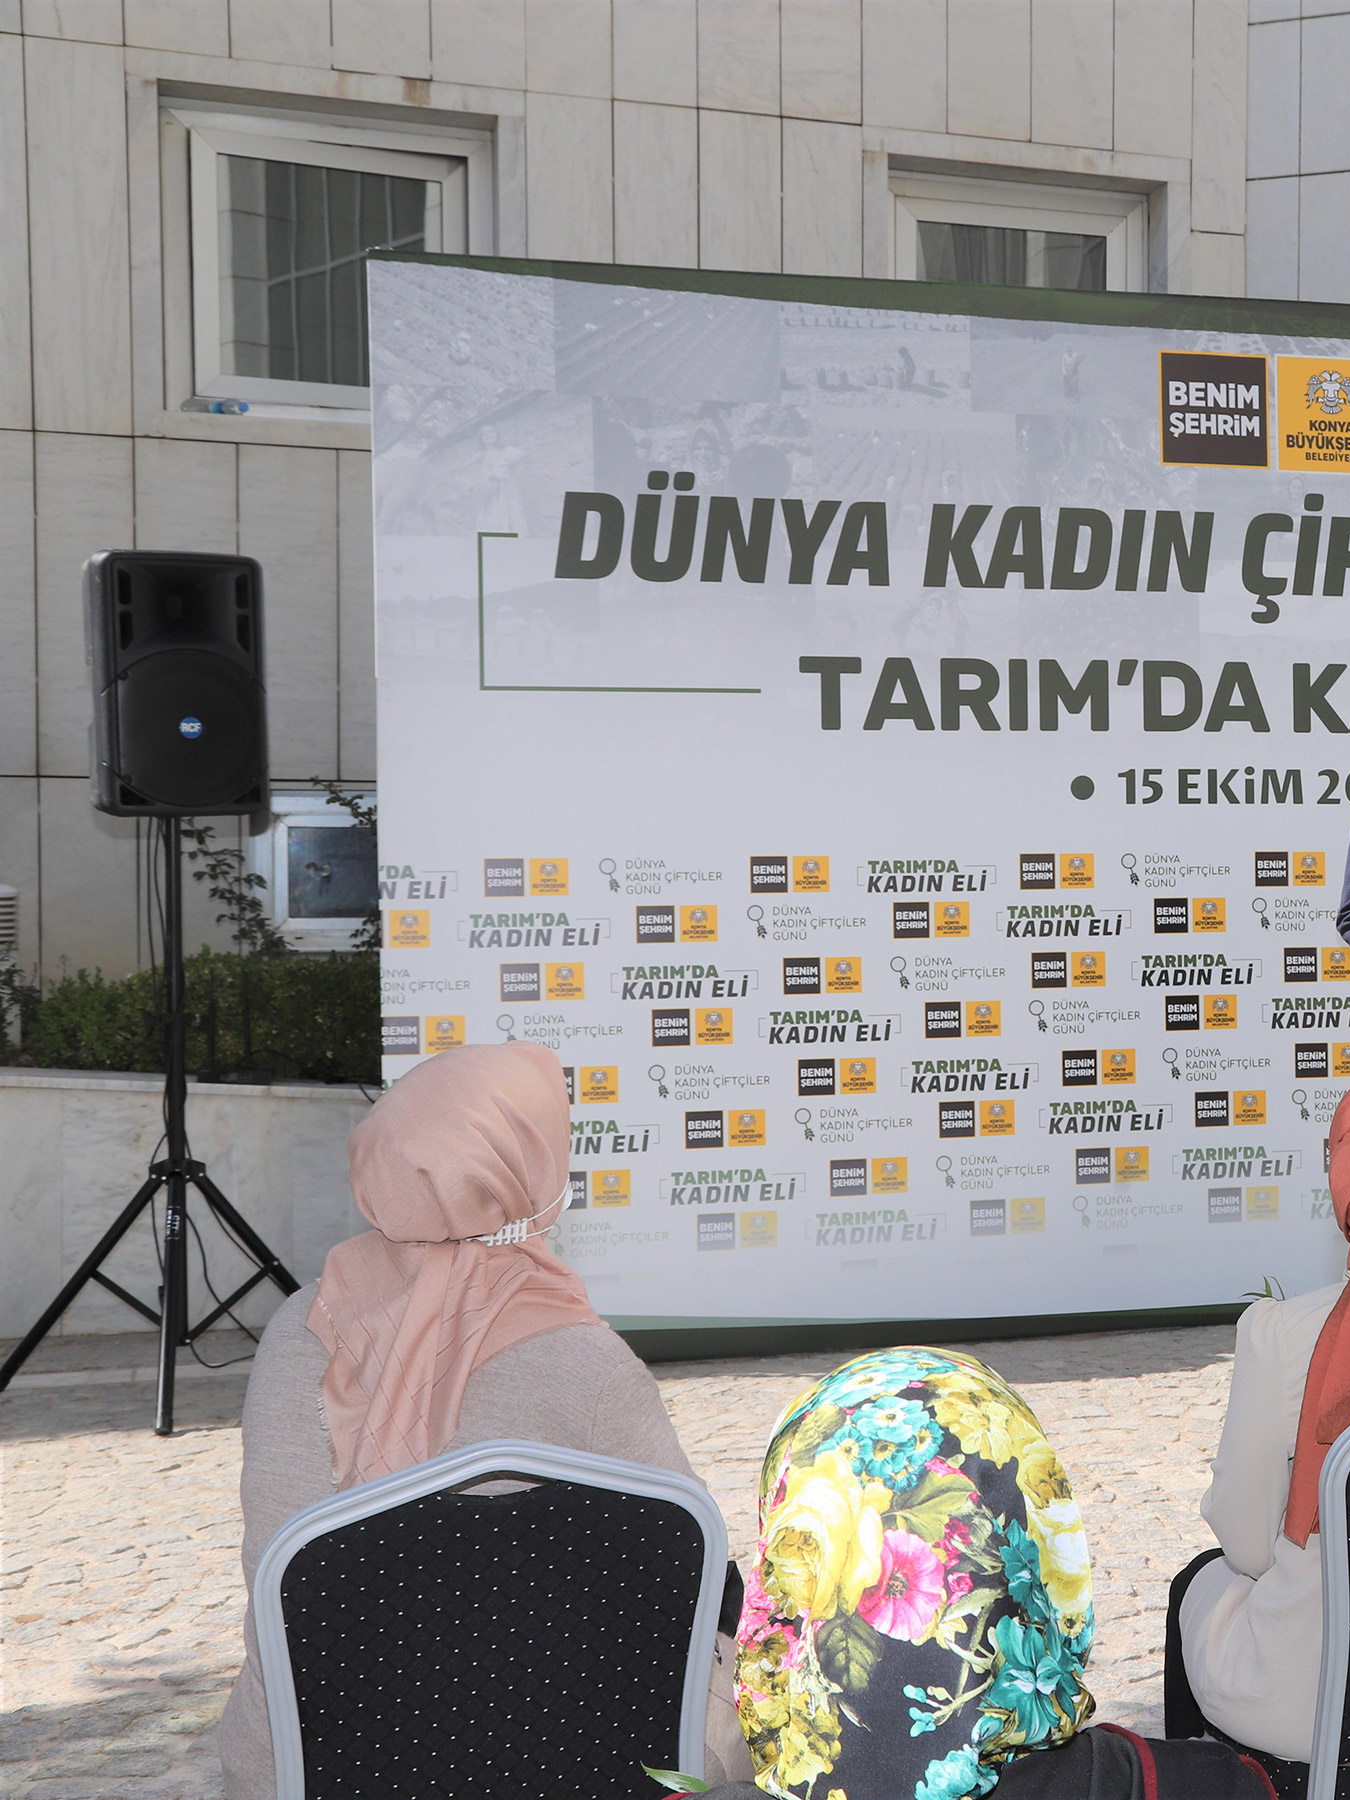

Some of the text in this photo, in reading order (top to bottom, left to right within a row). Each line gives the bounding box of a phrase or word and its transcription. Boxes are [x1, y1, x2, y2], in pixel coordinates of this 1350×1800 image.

[555, 471, 890, 587] DÜNYA
[924, 504, 1214, 593] KADIN
[799, 656, 1271, 732] TARIM'DA
[181, 722, 201, 732] RCF
[1118, 768, 1164, 804] 15
[625, 857, 666, 870] DÜNYA
[1144, 853, 1181, 864] DÜNYA
[868, 859, 959, 874] TARIM'DA
[1144, 864, 1230, 878] KADIN ÇİFTÇİLER
[625, 869, 723, 884] KADIN ÇİFTÇİLER
[867, 875, 943, 893] KADIN
[1144, 876, 1176, 888] GÜNÜ
[625, 883, 661, 895] GÜNÜ
[772, 904, 812, 916] DÜNYA
[1007, 904, 1096, 919] TARIM'DA
[469, 912, 570, 928] TARIM'DA
[773, 916, 866, 930] KADIN ÇİFTÇİLER
[772, 929, 807, 941] GÜNÜ
[1006, 919, 1080, 938] KADIN
[469, 928, 552, 948] KADIN
[915, 955, 953, 967] DÜNYA
[1141, 954, 1227, 968] TARIM'DA
[622, 964, 719, 980] TARIM'DA
[915, 966, 1006, 980] KADIN ÇİFTÇİLER
[1141, 968, 1212, 987] KADIN
[622, 980, 702, 1000] KADIN
[915, 979, 948, 991] GÜNÜ
[1052, 999, 1090, 1010] DÜNYA
[769, 1009, 863, 1025] TARIM'DA
[1053, 1009, 1141, 1024] KADIN ÇİFTÇİLER
[1271, 1011, 1341, 1029] KADIN
[769, 1025, 847, 1044] KADIN
[1052, 1022, 1085, 1035] GÜNÜ
[1185, 1047, 1221, 1058] DÜNYA
[911, 1058, 1002, 1074] TARIM'DA
[1185, 1057, 1271, 1071] KADIN ÇİFTÇİLER
[911, 1074, 986, 1093] KADIN
[1185, 1070, 1217, 1082] GÜNÜ
[820, 1107, 859, 1119] DÜNYA
[1049, 1099, 1137, 1116] TARIM'DA
[820, 1116, 913, 1132] KADIN ÇİFTÇİLER
[1049, 1115, 1122, 1135] KADIN
[820, 1131, 854, 1143] GÜNÜ
[1182, 1146, 1267, 1162] TARIM'DA
[671, 1168, 767, 1186] TARIM'DA
[1181, 1161, 1252, 1180] KADIN
[670, 1184, 750, 1206] KADIN
